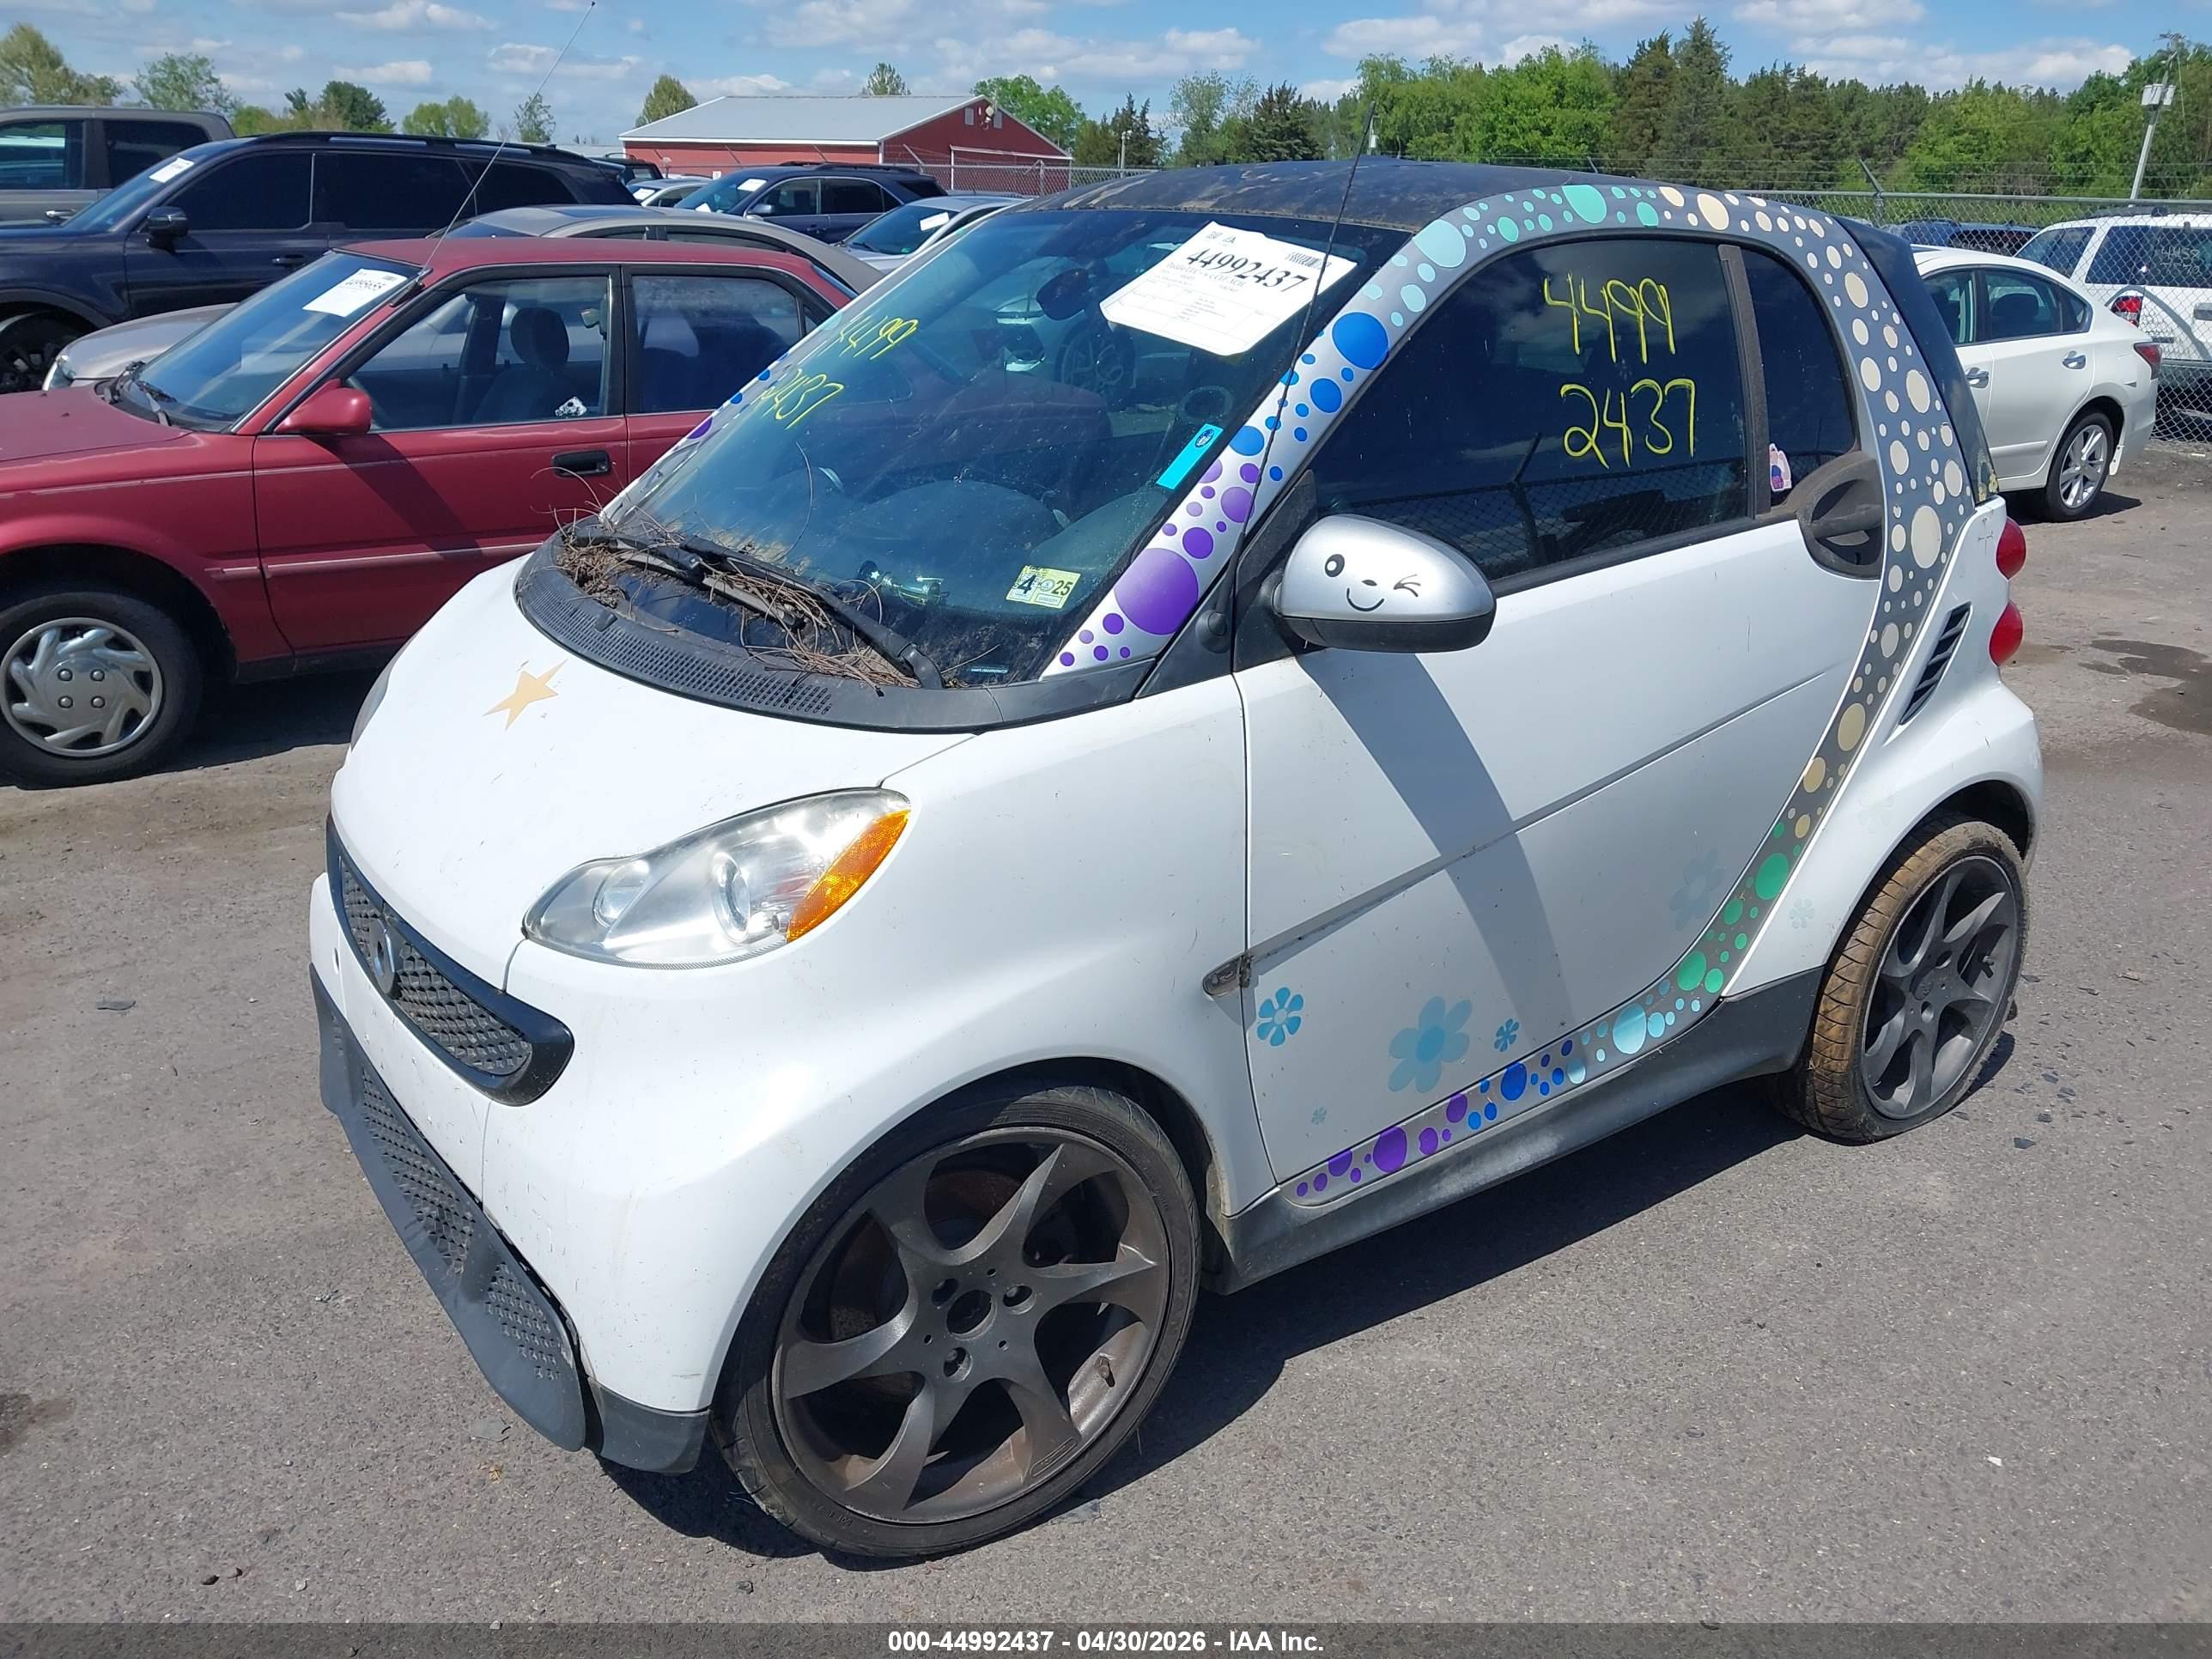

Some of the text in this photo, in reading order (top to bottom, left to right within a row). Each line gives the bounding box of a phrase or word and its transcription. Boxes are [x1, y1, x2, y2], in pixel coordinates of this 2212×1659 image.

[1187, 248, 1310, 292] 44992437
[1543, 270, 1676, 365] 4499
[1560, 378, 1697, 470] 2437
[1018, 574, 1036, 593] 4
[1051, 580, 1073, 595] 25
